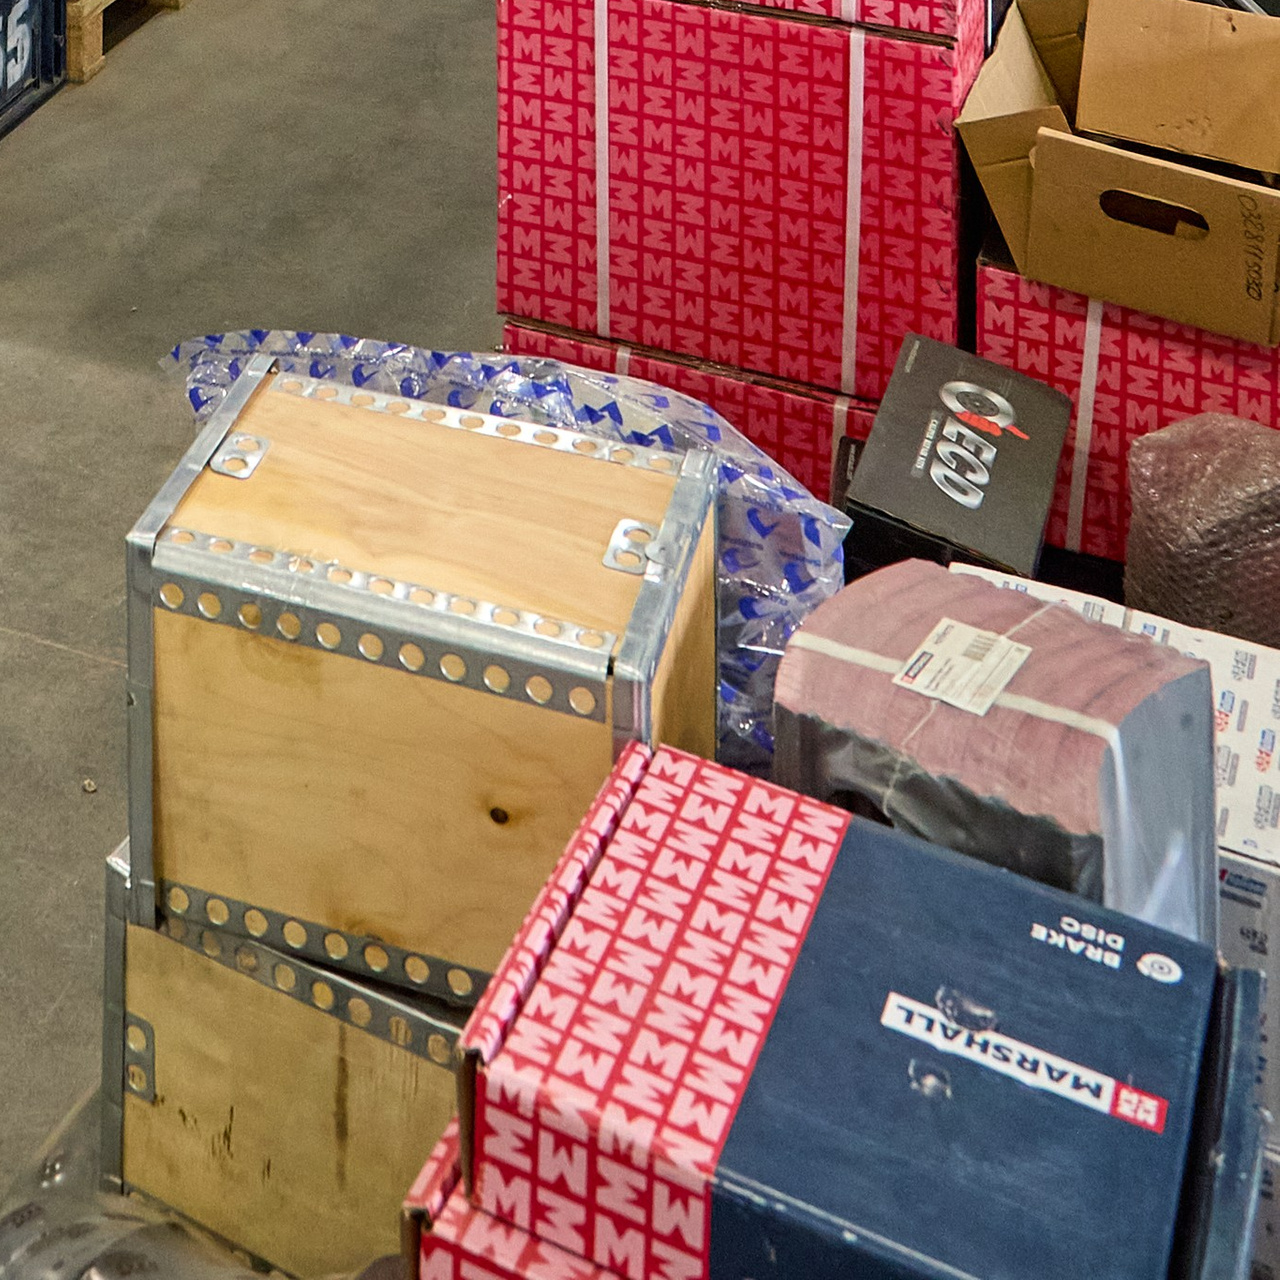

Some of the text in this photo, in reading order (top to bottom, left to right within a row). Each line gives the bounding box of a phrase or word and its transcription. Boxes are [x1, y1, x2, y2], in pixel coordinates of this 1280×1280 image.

[1030, 923, 1121, 969] BRAKE
[1060, 916, 1125, 951] DISC
[897, 1004, 1103, 1099] MARSHALL
